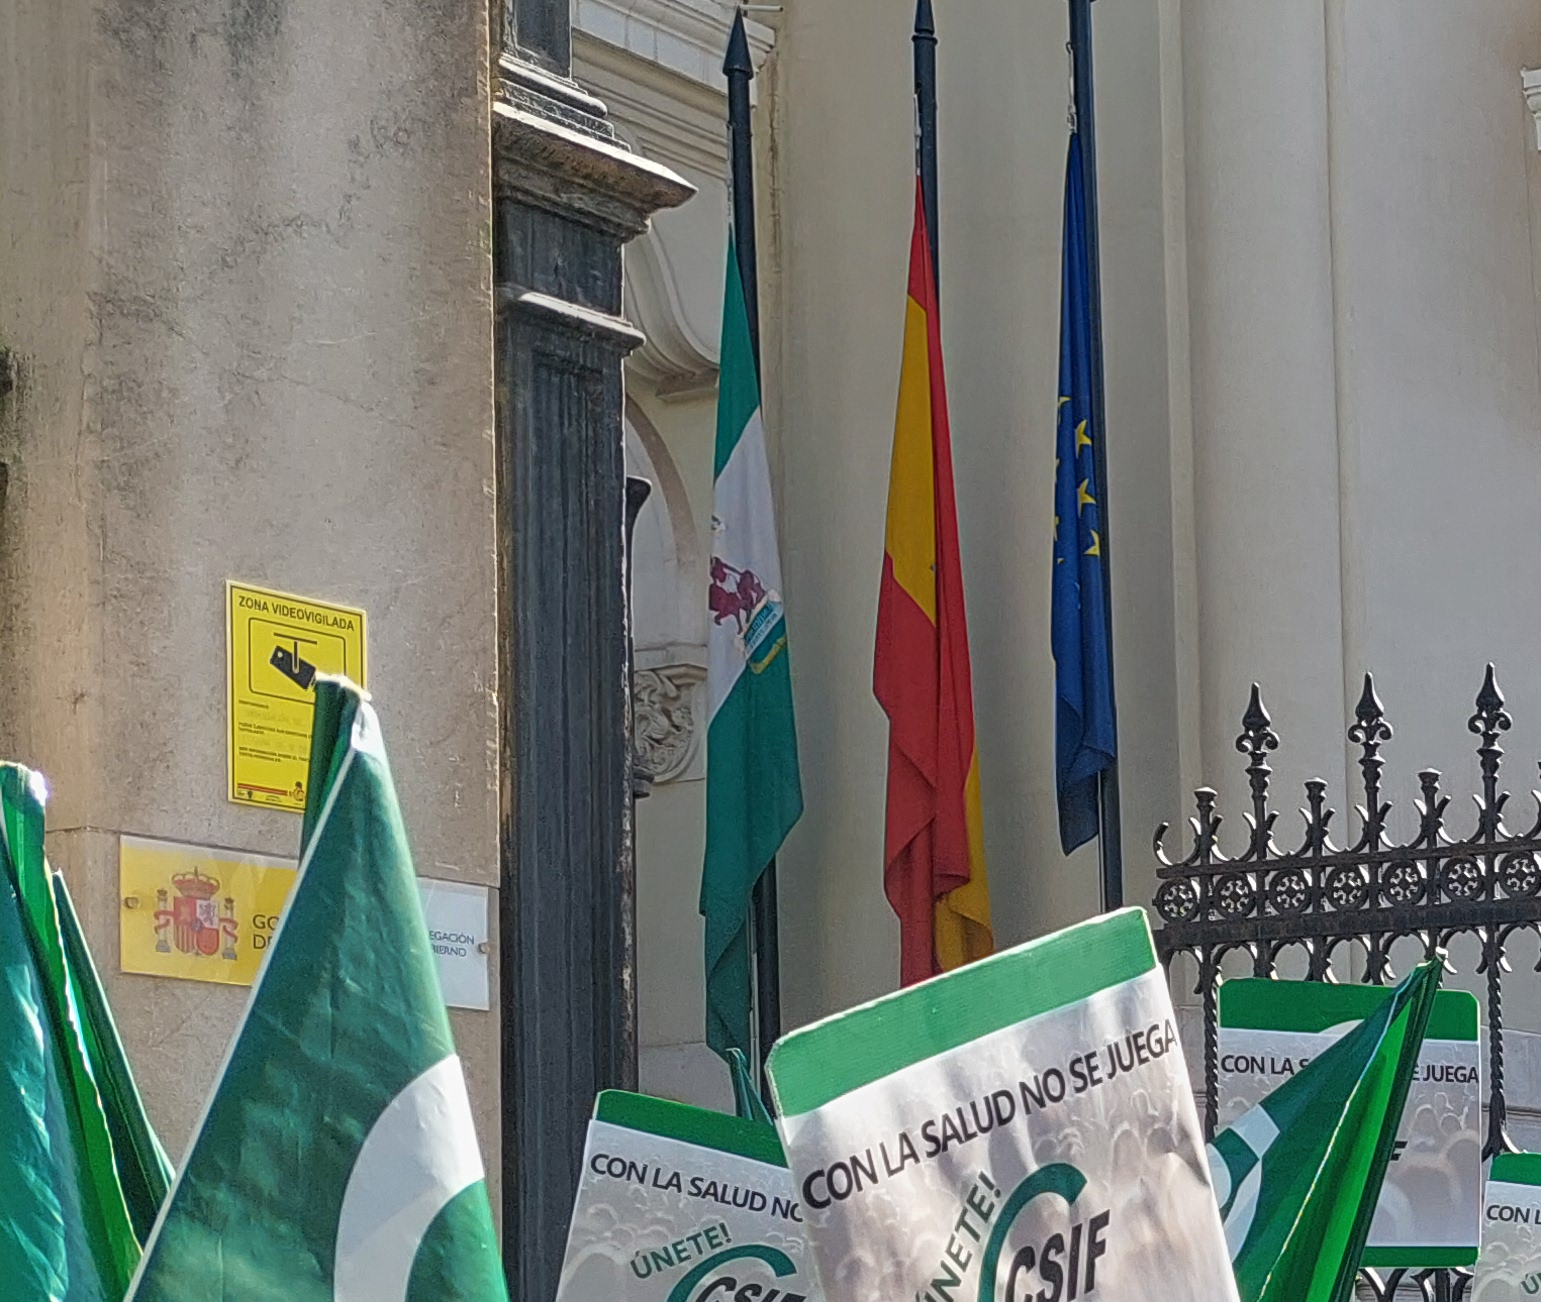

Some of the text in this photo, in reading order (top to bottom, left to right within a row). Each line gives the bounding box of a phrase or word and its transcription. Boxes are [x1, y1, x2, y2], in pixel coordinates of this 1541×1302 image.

[238, 595, 355, 632] ZONA VIDEOVIGILADA
[1220, 1055, 1265, 1075] CON
[1270, 1057, 1294, 1076] LA
[1422, 1065, 1478, 1084] JUEGA
[802, 1018, 1178, 1210] CON LA SALUD NO SE JUEGA
[590, 1153, 648, 1184] CON
[652, 1168, 682, 1194] LA
[686, 1177, 768, 1213] SALUD
[1486, 1204, 1530, 1224] CON
[630, 1222, 733, 1280] ÚNETE!
